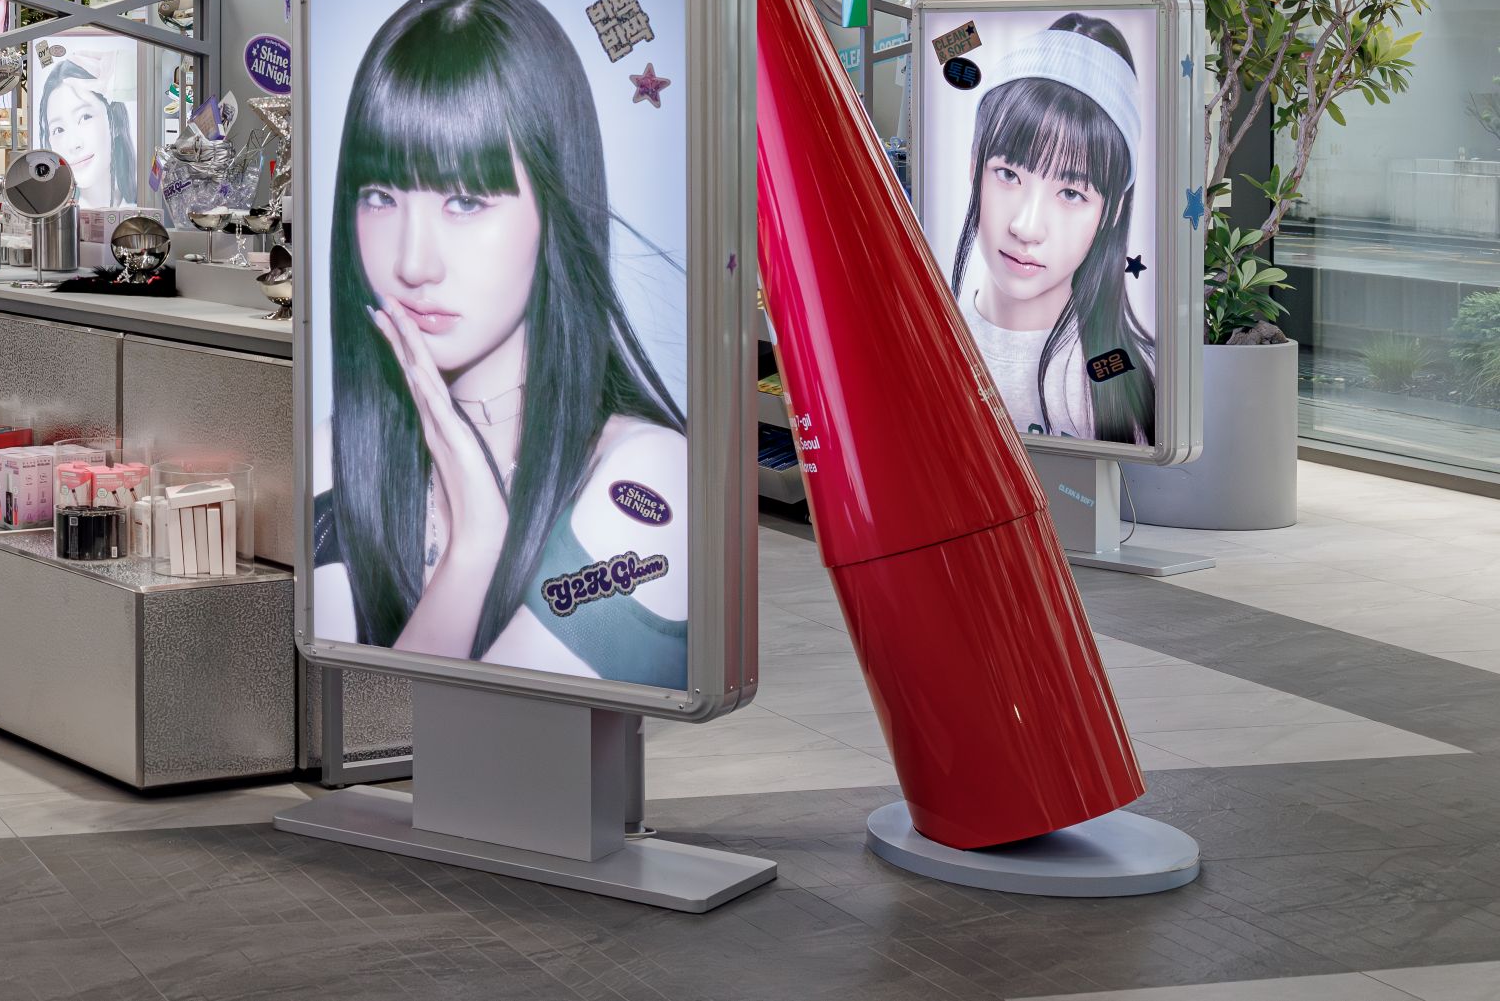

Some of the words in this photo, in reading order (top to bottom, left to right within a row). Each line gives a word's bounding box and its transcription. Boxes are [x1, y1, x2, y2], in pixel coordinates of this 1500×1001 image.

[251, 58, 266, 75] All
[260, 45, 289, 69] Shine
[616, 493, 632, 508] All
[631, 499, 663, 522] Night
[627, 487, 658, 509] Shine
